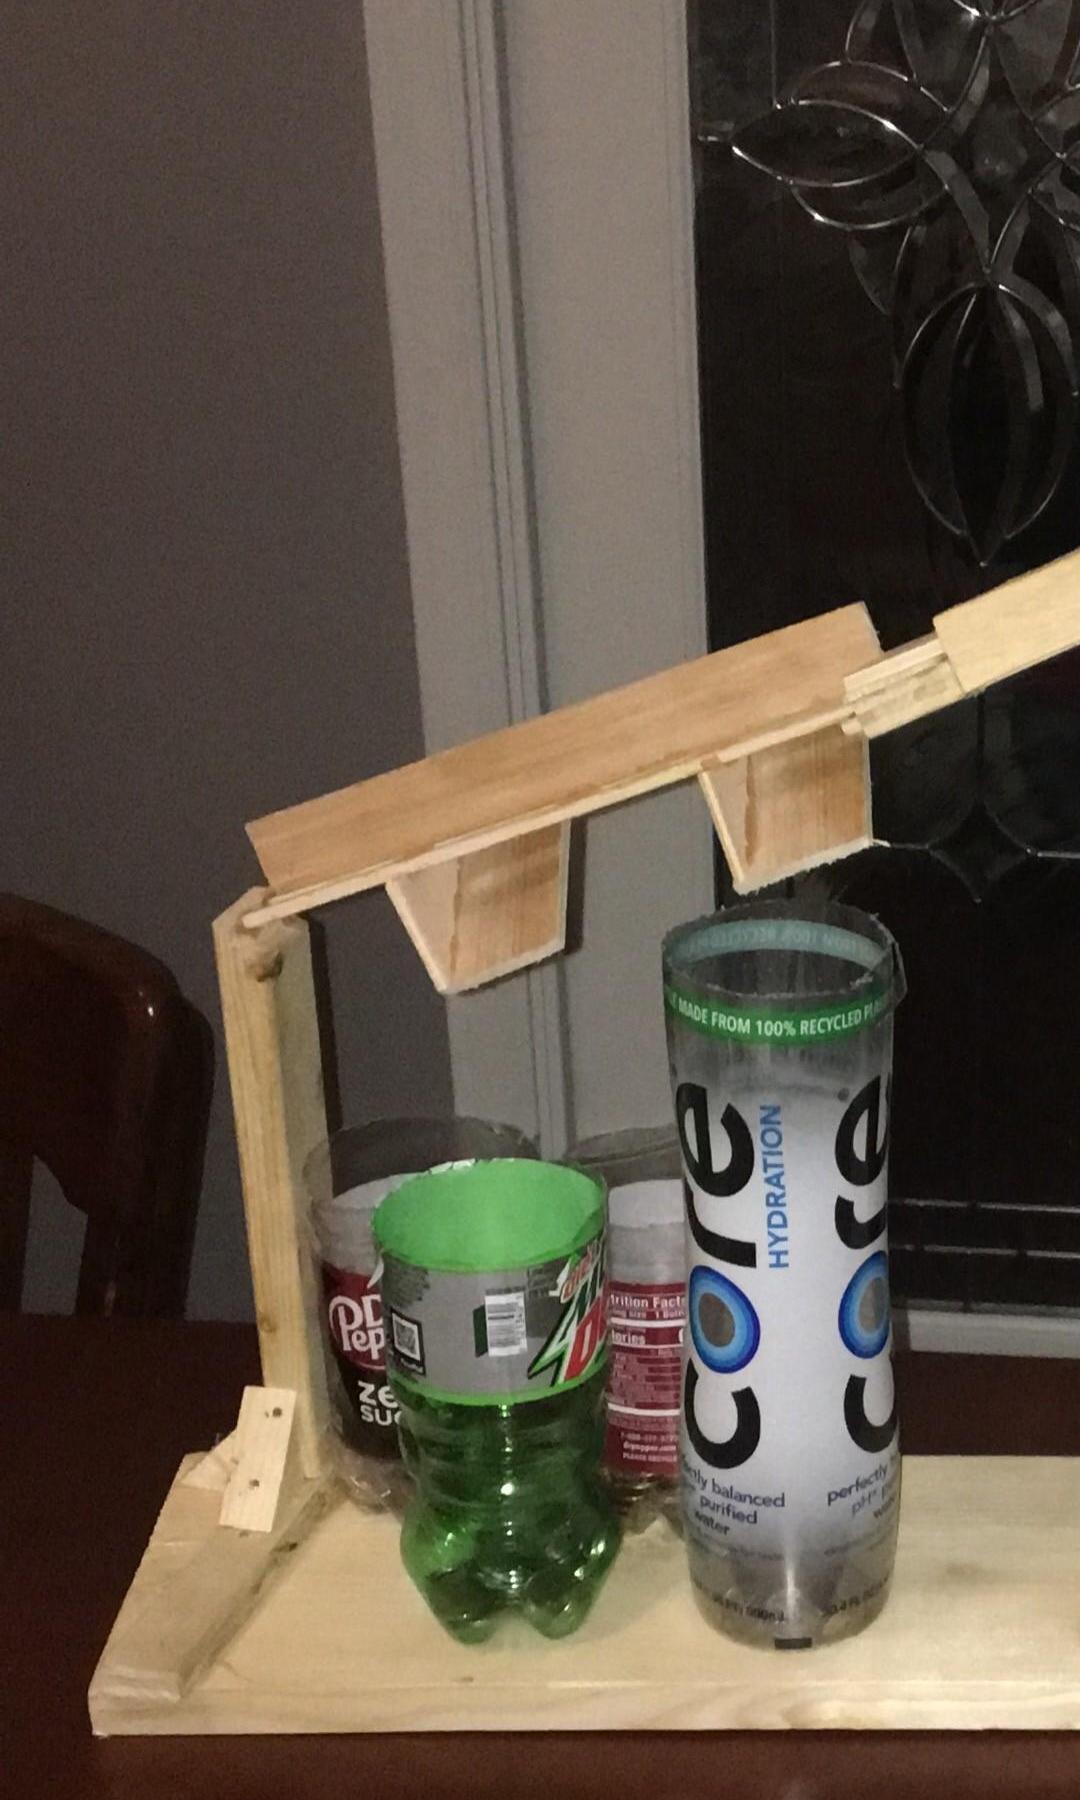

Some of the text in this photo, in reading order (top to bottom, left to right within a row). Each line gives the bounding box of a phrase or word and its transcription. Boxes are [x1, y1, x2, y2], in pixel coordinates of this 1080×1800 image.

[678, 998, 708, 1026] MADE
[711, 1012, 751, 1034] FROM
[757, 1021, 796, 1037] 100%
[800, 1008, 862, 1036] RECYCLED
[759, 1104, 790, 1269] HYDRATION
[357, 1380, 400, 1409] ze
[711, 1478, 786, 1508] balanced
[827, 1463, 888, 1507] perfectly
[700, 1495, 758, 1525] purified
